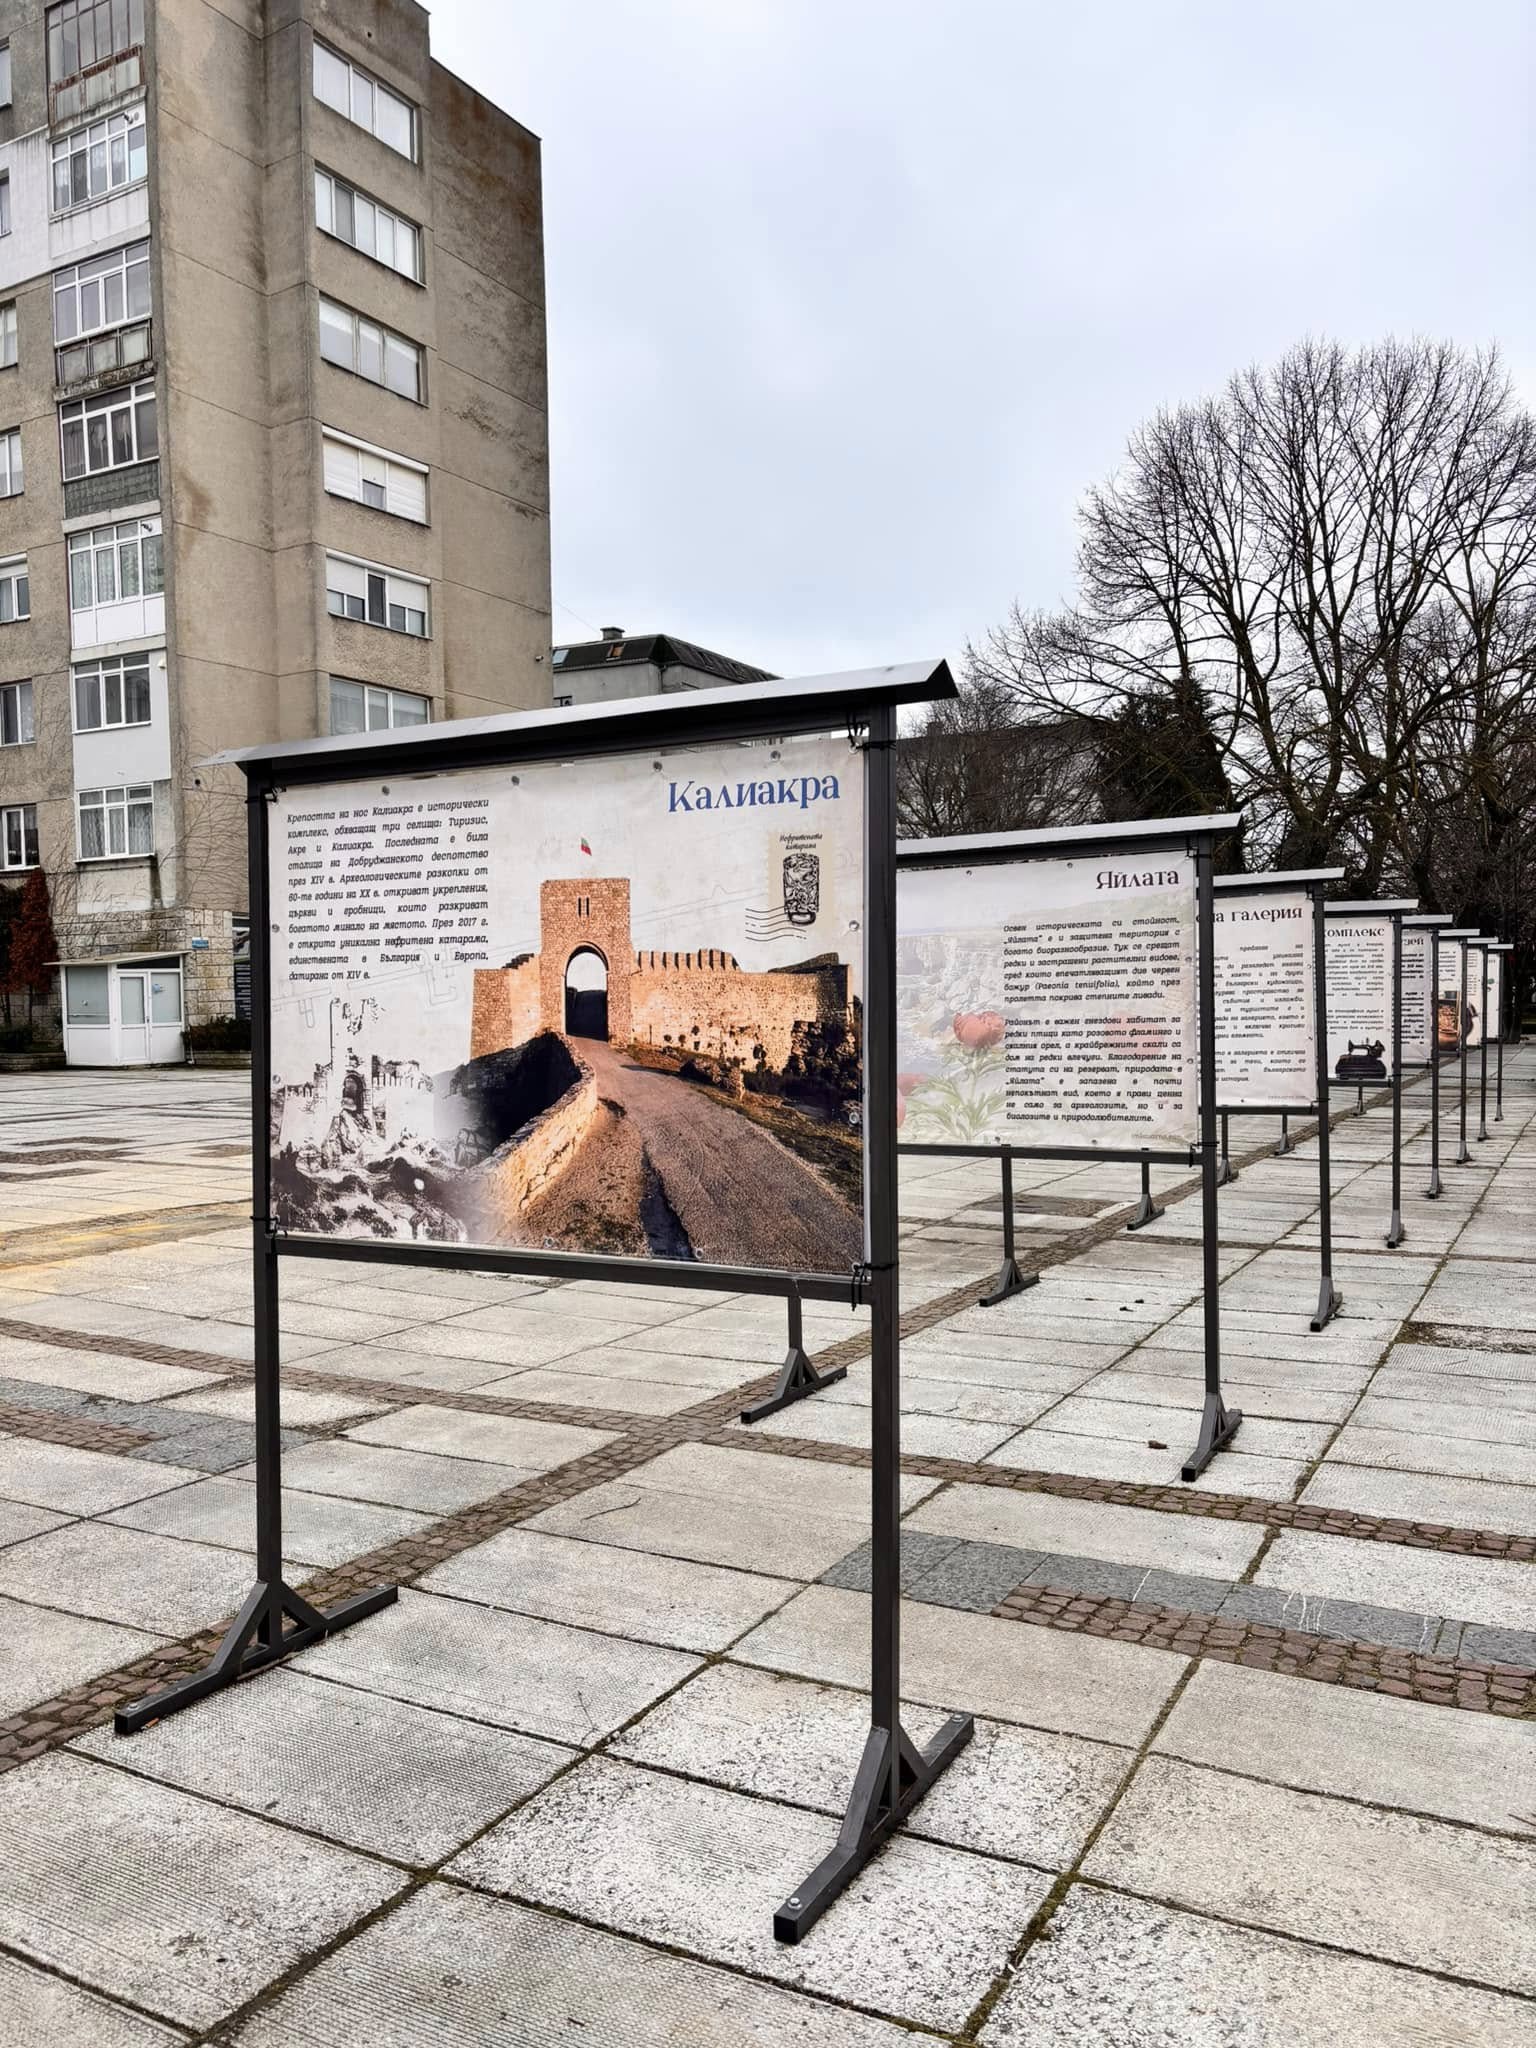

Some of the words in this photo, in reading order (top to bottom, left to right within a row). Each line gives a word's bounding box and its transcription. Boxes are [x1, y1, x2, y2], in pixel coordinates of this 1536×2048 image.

[668, 775, 840, 813] Калиакра
[287, 812, 335, 824] Крепостта
[353, 809, 368, 817] нос
[372, 806, 413, 815] Калиакра
[427, 800, 489, 811] исторически
[288, 829, 328, 838] комплекс,
[334, 825, 376, 835] обхващащ
[382, 823, 400, 832] три
[406, 820, 442, 829] селища:
[288, 846, 306, 855] Акре
[332, 841, 374, 851] Калиакра.
[385, 836, 439, 847] Последната
[466, 832, 488, 842] била
[288, 861, 322, 870] столица
[348, 854, 423, 867] Добруджанското
[431, 850, 488, 861] деспотство
[288, 878, 306, 887] през
[310, 875, 324, 884] XIV
[340, 871, 421, 884] Археологическите
[426, 869, 469, 880] разкопки
[474, 867, 488, 875] от
[1096, 869, 1179, 889] Яйлата
[315, 891, 343, 900] години
[359, 889, 370, 897] XX
[384, 887, 429, 897] откриват
[433, 884, 488, 896] укрепления,
[289, 909, 317, 919] църкви
[344, 904, 386, 916] гробници,
[397, 904, 427, 912] които
[438, 901, 488, 912] разкриват
[1231, 908, 1302, 922] галерия
[289, 924, 329, 933] богатото
[333, 923, 365, 931] минало
[369, 922, 379, 930] на
[383, 921, 427, 929] мястото.
[432, 918, 453, 929] През
[458, 917, 476, 926] 2017
[1036, 921, 1102, 930] историческата
[1325, 928, 1385, 937] омплекс
[298, 940, 335, 950] открита
[340, 939, 380, 949] уникална
[385, 936, 433, 947] нефритена
[439, 936, 488, 945] катарама,
[1114, 944, 1129, 952] Тук
[1145, 942, 1180, 950] срещат
[289, 956, 348, 964] единствената
[380, 953, 420, 963] България
[454, 951, 488, 962] Европа,
[1004, 960, 1026, 968] редки
[289, 971, 328, 982] датирана
[346, 970, 361, 979] XIV
[1004, 971, 1022, 980] сред
[1151, 967, 1180, 975] червен
[1004, 983, 1030, 991] бажур
[1035, 981, 1069, 989] (Paeonia
[1161, 979, 1180, 987] през
[1004, 1030, 1028, 1039] редки
[1074, 1041, 1138, 1049] крайбрежните
[1039, 1054, 1062, 1062] редки
[1108, 1053, 1167, 1061] Благодарение
[1006, 1112, 1050, 1120] биолозите
